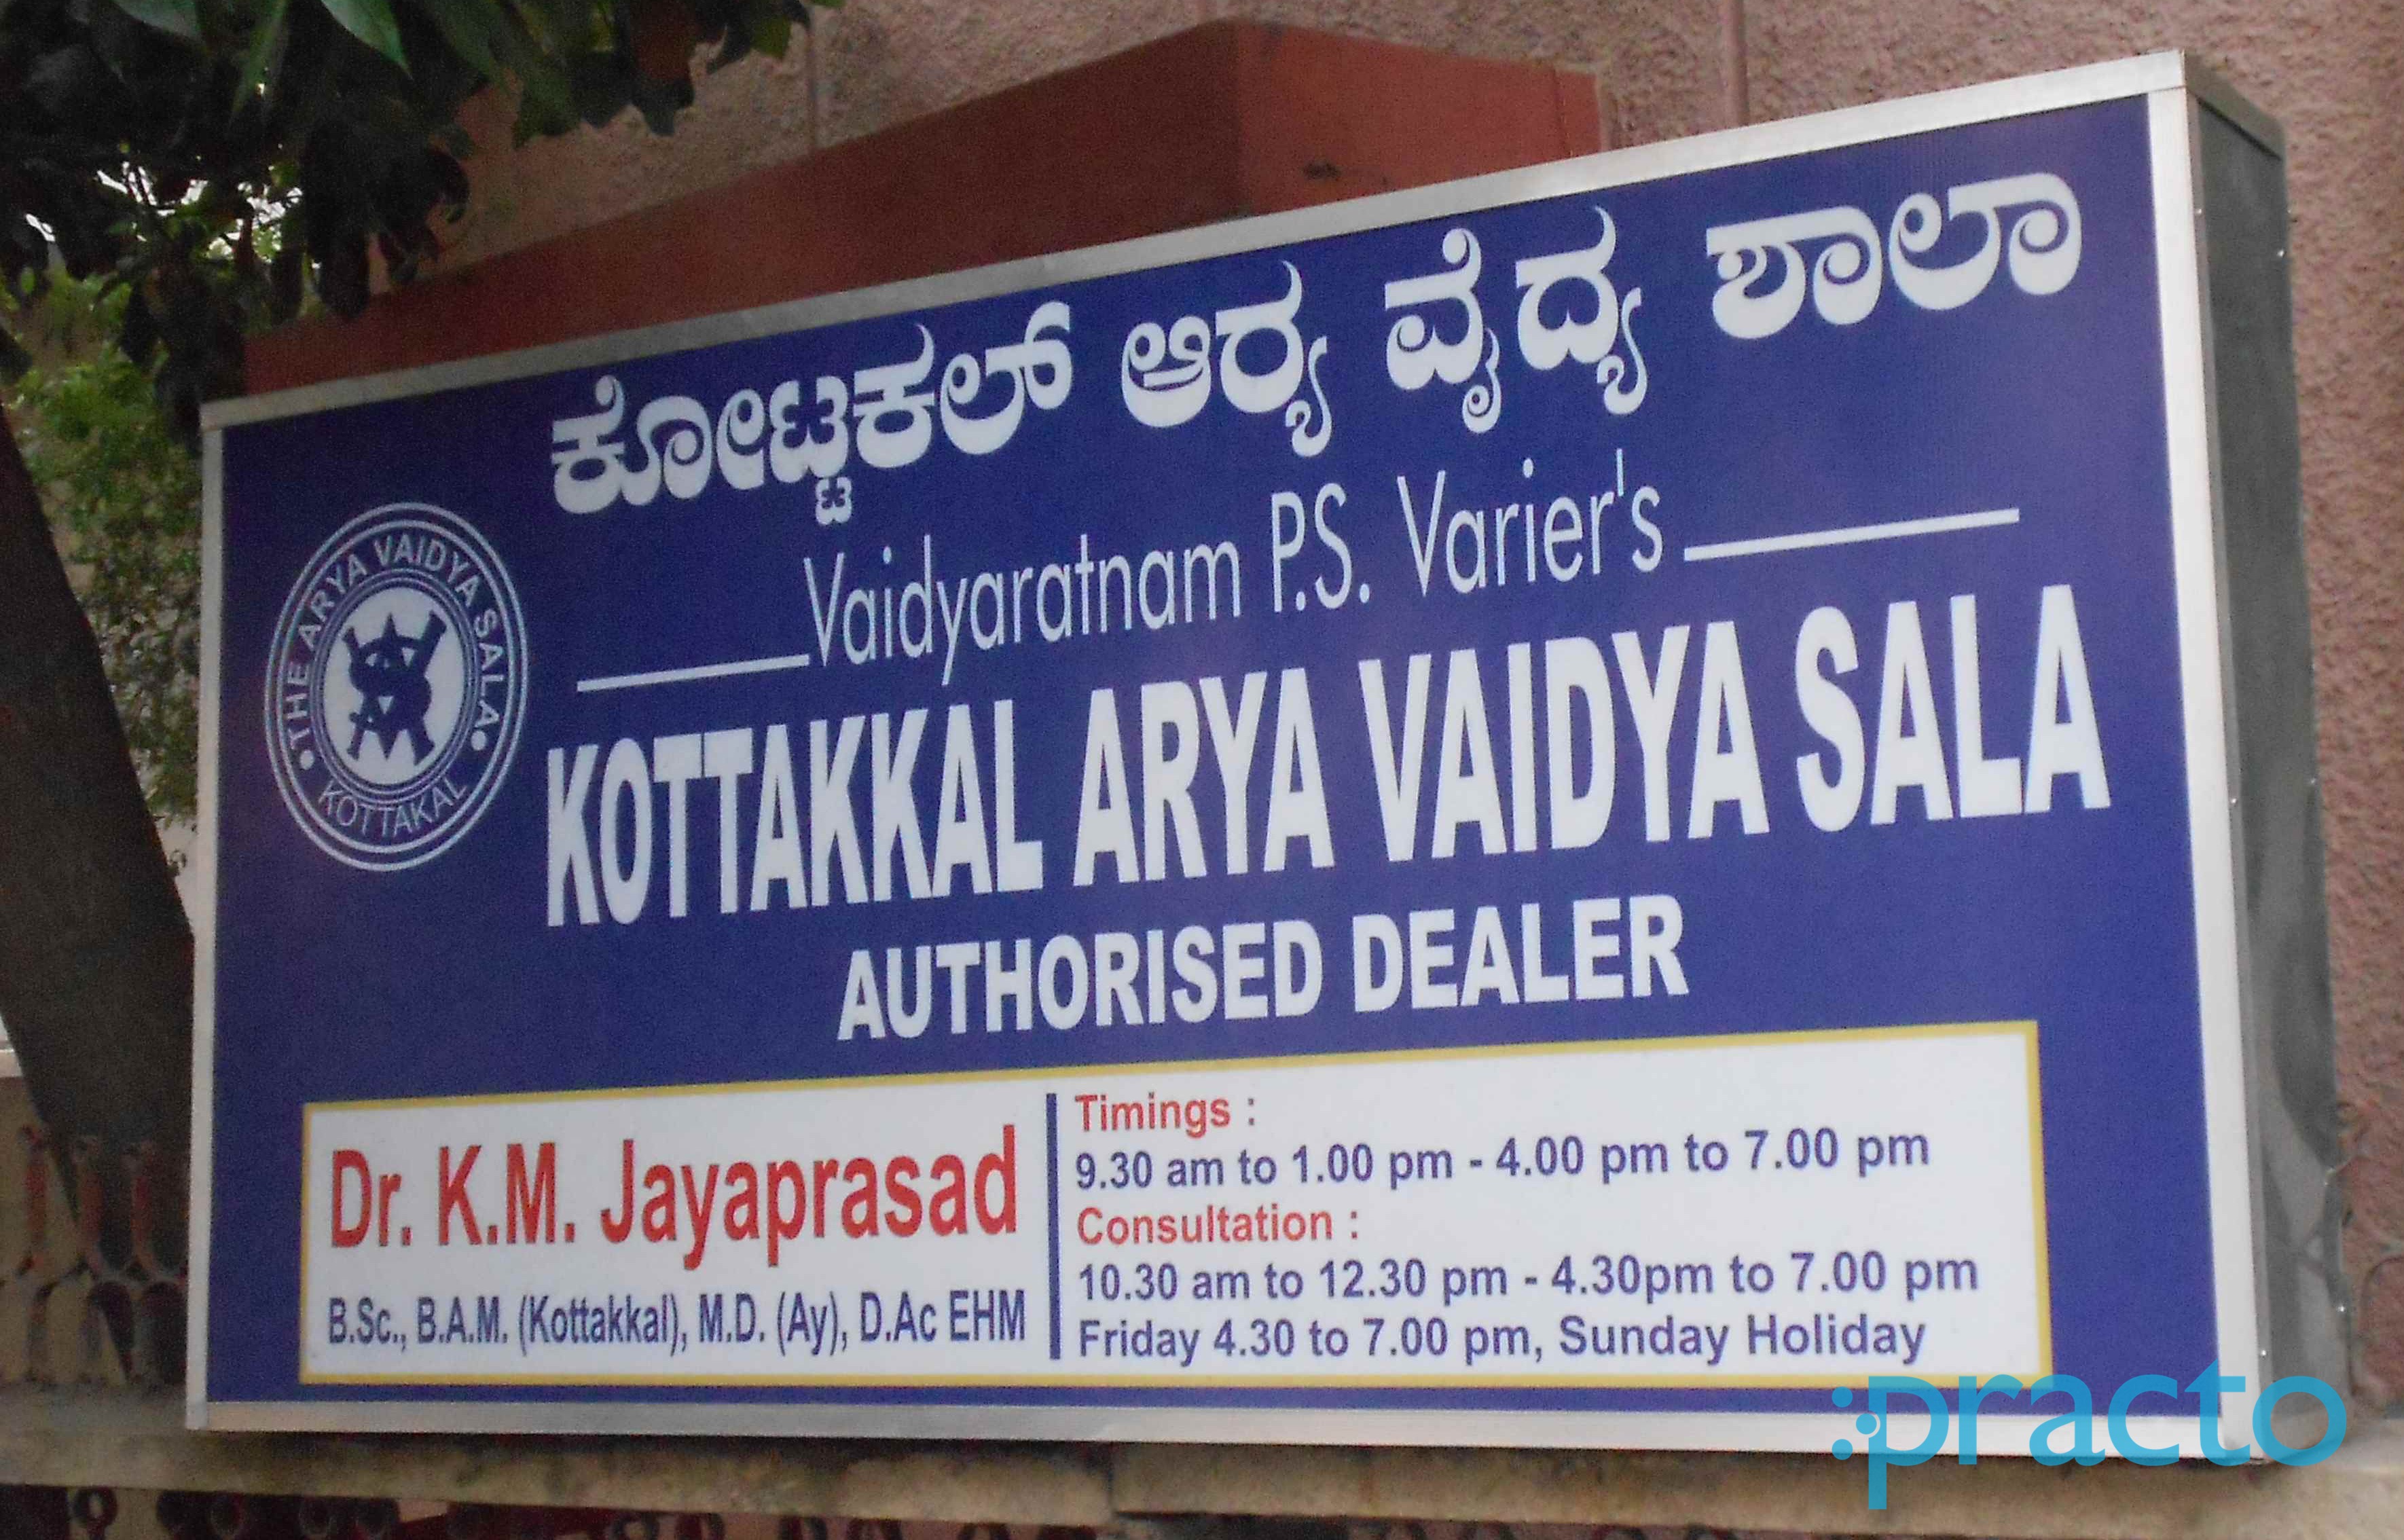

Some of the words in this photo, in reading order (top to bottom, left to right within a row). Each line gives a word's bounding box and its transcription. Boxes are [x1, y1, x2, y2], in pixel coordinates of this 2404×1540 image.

[1385, 206, 1650, 434] ವೈದ್ಯ
[1706, 172, 2081, 340] ಶಾಲಾ
[804, 534, 1242, 686] Vaidyaratnam
[1271, 483, 1370, 612] P.S.
[1398, 447, 1663, 597] Varier's
[287, 663, 311, 750] THE
[300, 554, 369, 652] ARYA
[374, 534, 480, 608] VAIDYA
[473, 610, 505, 729] SALA
[547, 700, 1043, 927] KOTTAKKAL
[1074, 668, 1334, 886] ARYA
[1358, 620, 1770, 862] VAIDYA
[1795, 584, 2111, 832] SALA
[318, 775, 469, 838] KOTTAKAL
[838, 919, 1323, 1040] AUTHORISED
[1352, 894, 1690, 1012] DEALER
[1075, 1092, 1231, 1138] Timings
[1076, 1151, 1152, 1189] 9.30
[1167, 1155, 1224, 1188] am
[1239, 1150, 1277, 1185] to
[1292, 1143, 1373, 1184] 1.00
[1389, 1150, 1453, 1190] pm
[1496, 1135, 1584, 1177] 4.00
[1601, 1142, 1669, 1184] pm
[1684, 1134, 1729, 1172] to
[1745, 1127, 1838, 1170] 7.00
[1857, 1133, 1929, 1177] pm
[331, 1149, 411, 1248] Dr.
[438, 1142, 575, 1246] K.M.
[601, 1124, 1017, 1270] Jayaprasad
[1077, 1203, 1333, 1245] Consultation
[1079, 1262, 1178, 1300] 10.30
[1192, 1267, 1250, 1300] am
[1264, 1262, 1304, 1298] to
[1319, 1258, 1426, 1299] 12.30
[1442, 1264, 1507, 1306] pm
[1551, 1255, 1714, 1304] 4.30pm
[1730, 1255, 1774, 1293] to
[1791, 1250, 1887, 1293] 7.00
[1905, 1257, 1978, 1302] pm
[329, 1296, 407, 1353] B.Sc.,
[418, 1296, 507, 1344] B.A.M.
[519, 1294, 687, 1357] (Kottakkal),
[699, 1293, 764, 1342] M.D.
[777, 1291, 848, 1357] (Ay),
[860, 1291, 936, 1342] D.Ac
[950, 1289, 1025, 1342] EHM
[1079, 1319, 1199, 1368] Friday
[1214, 1319, 1293, 1357] 4.30
[1309, 1319, 1348, 1356] to
[1363, 1317, 1448, 1357] 7.00
[1464, 1323, 1543, 1366] pm,
[1560, 1315, 1729, 1366] Sunday
[1747, 1313, 1925, 1365] Holiday
